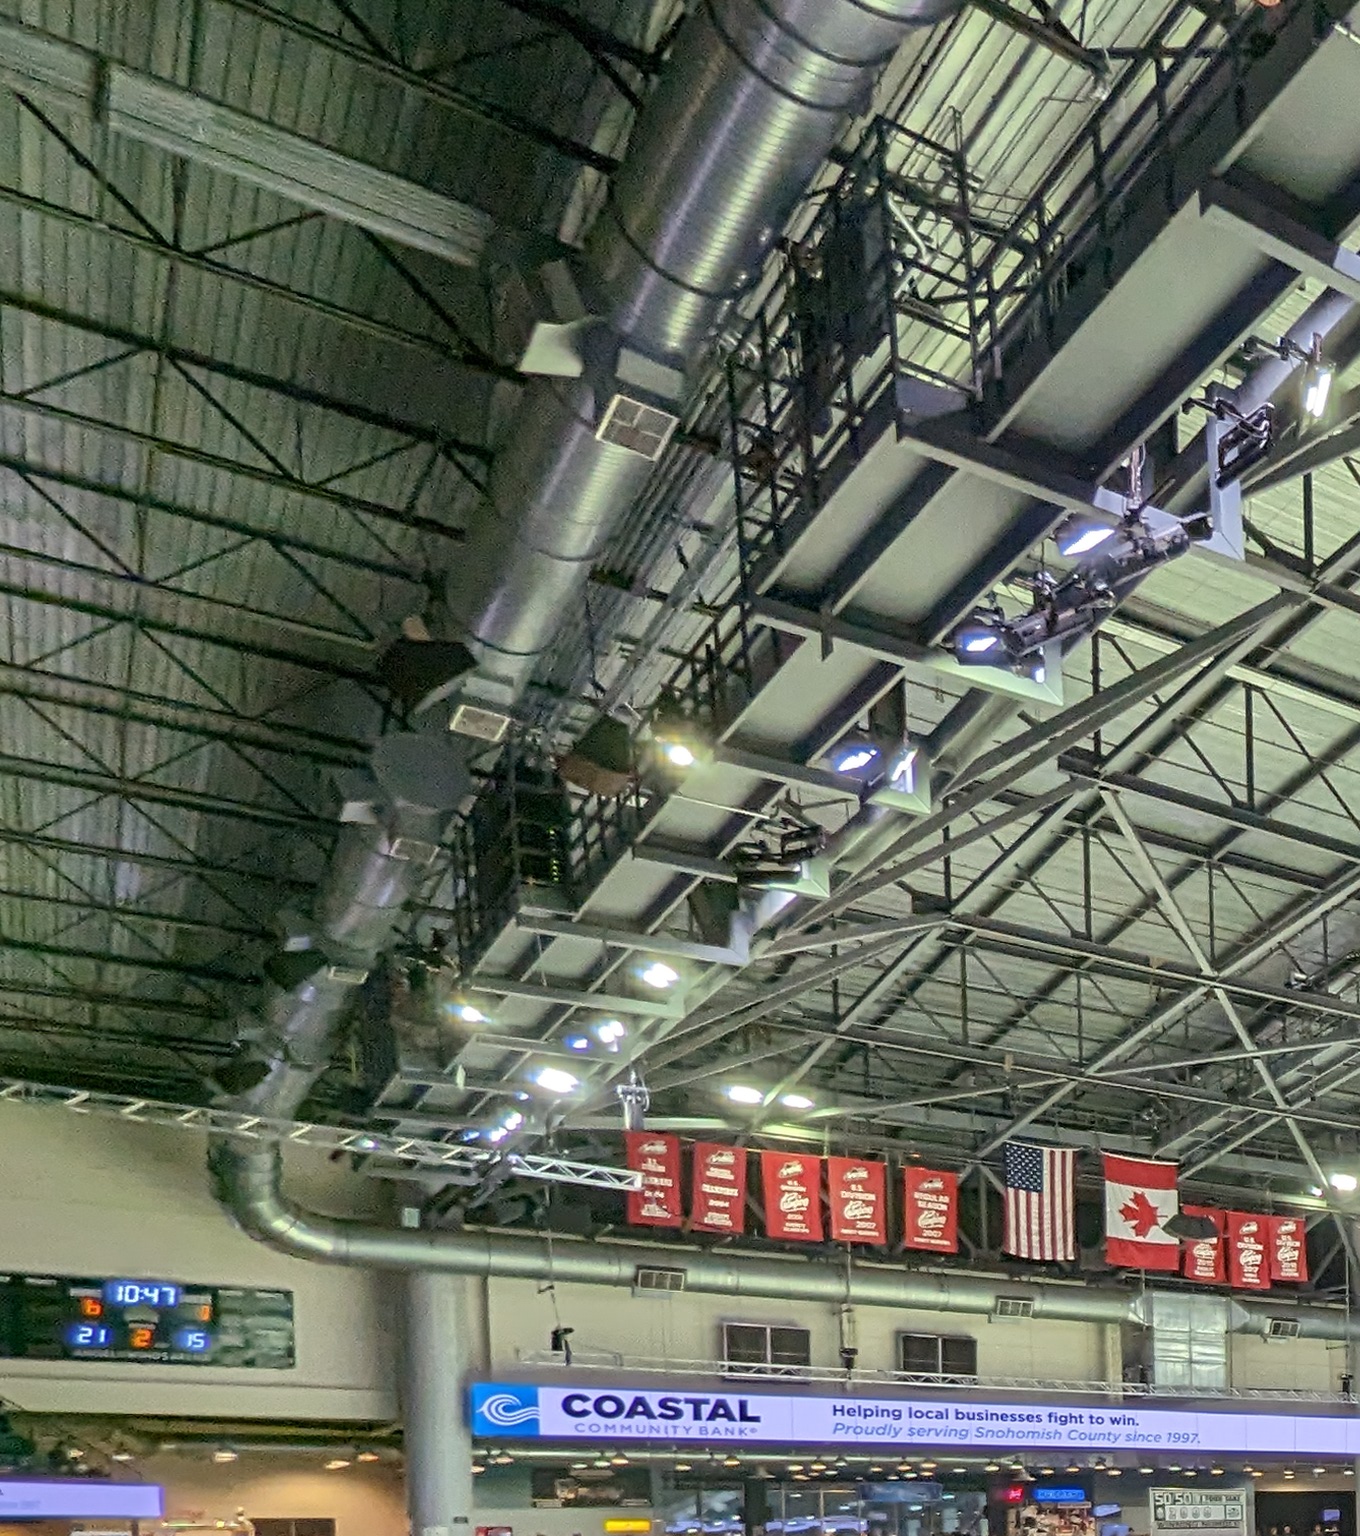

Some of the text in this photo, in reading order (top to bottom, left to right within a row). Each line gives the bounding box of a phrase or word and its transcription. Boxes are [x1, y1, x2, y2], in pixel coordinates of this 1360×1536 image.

[116, 1284, 176, 1305] 10:47
[78, 1327, 106, 1344] 21
[132, 1329, 152, 1348] 2
[186, 1333, 206, 1348] 15
[562, 1394, 761, 1423] COASTAL
[832, 1404, 1140, 1427] Helping local businesses fight to win.
[574, 1423, 691, 1436] COMMUNITY
[832, 1422, 1202, 1445] Proudly serving Snohomish County since 1997.
